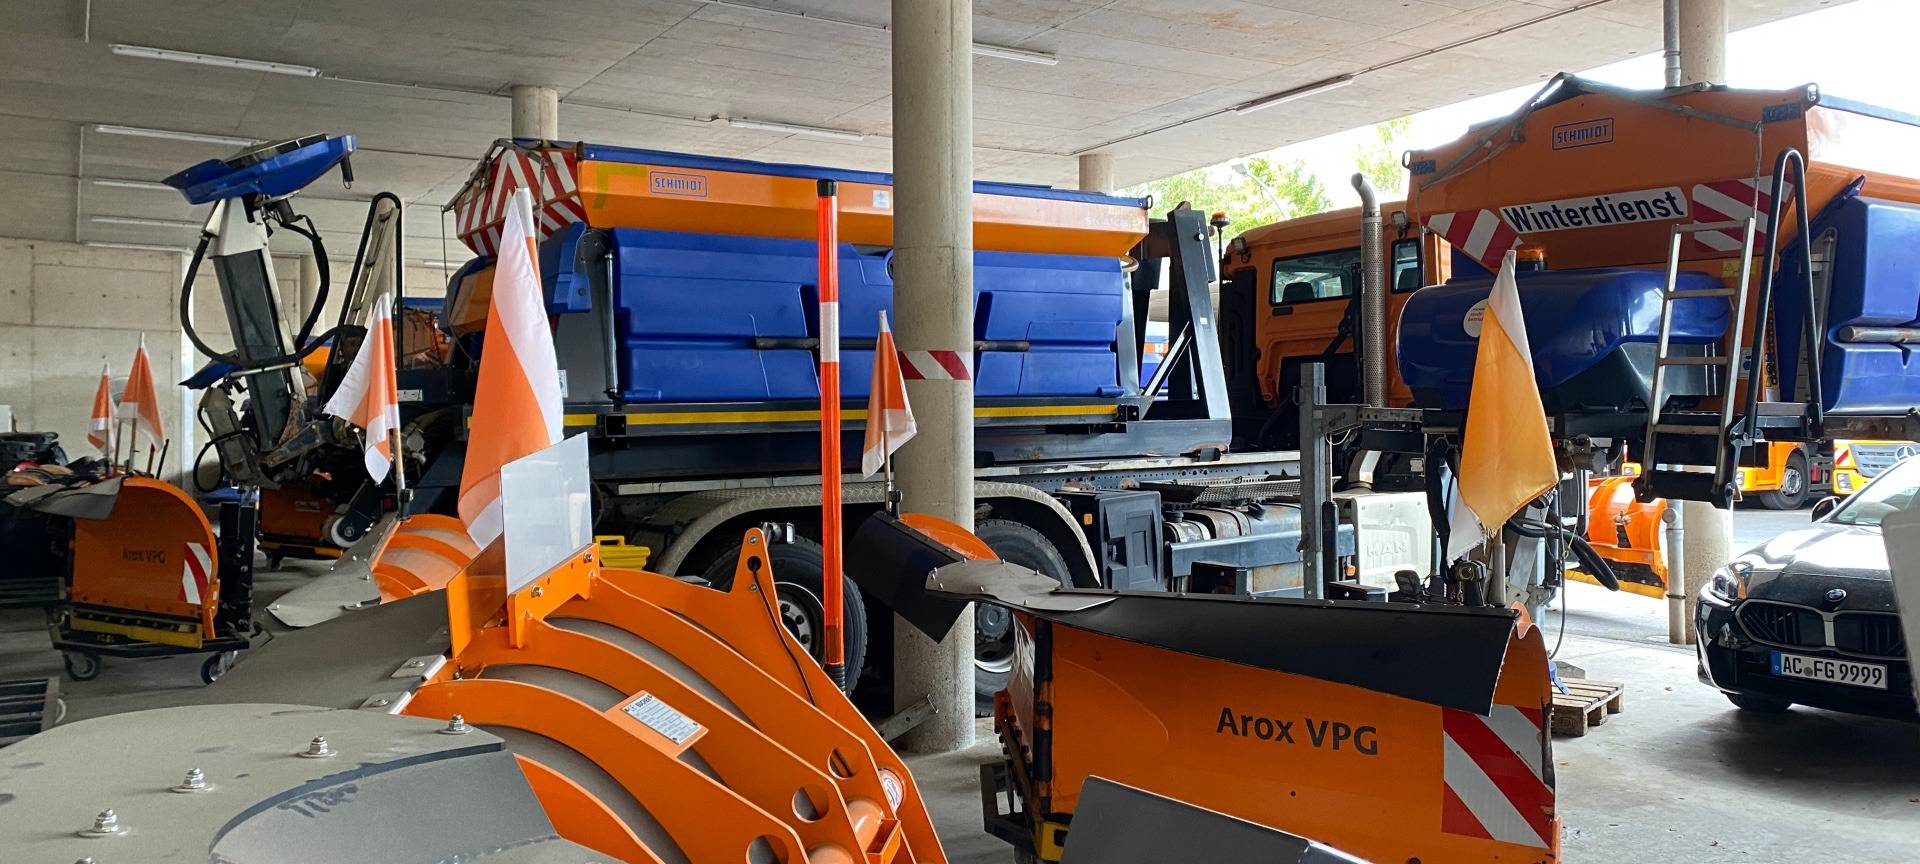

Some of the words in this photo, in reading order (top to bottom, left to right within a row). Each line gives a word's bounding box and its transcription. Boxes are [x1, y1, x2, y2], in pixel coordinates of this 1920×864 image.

[1557, 125, 1608, 144] SCHMIDT
[655, 177, 702, 191] SCHMIDT
[1503, 191, 1684, 233] Winterdienst
[1783, 656, 1803, 675] AC
[1813, 660, 1835, 680] FG
[1839, 663, 1883, 685] 9999
[1216, 707, 1296, 744] Arox
[1304, 718, 1378, 756] VPG
